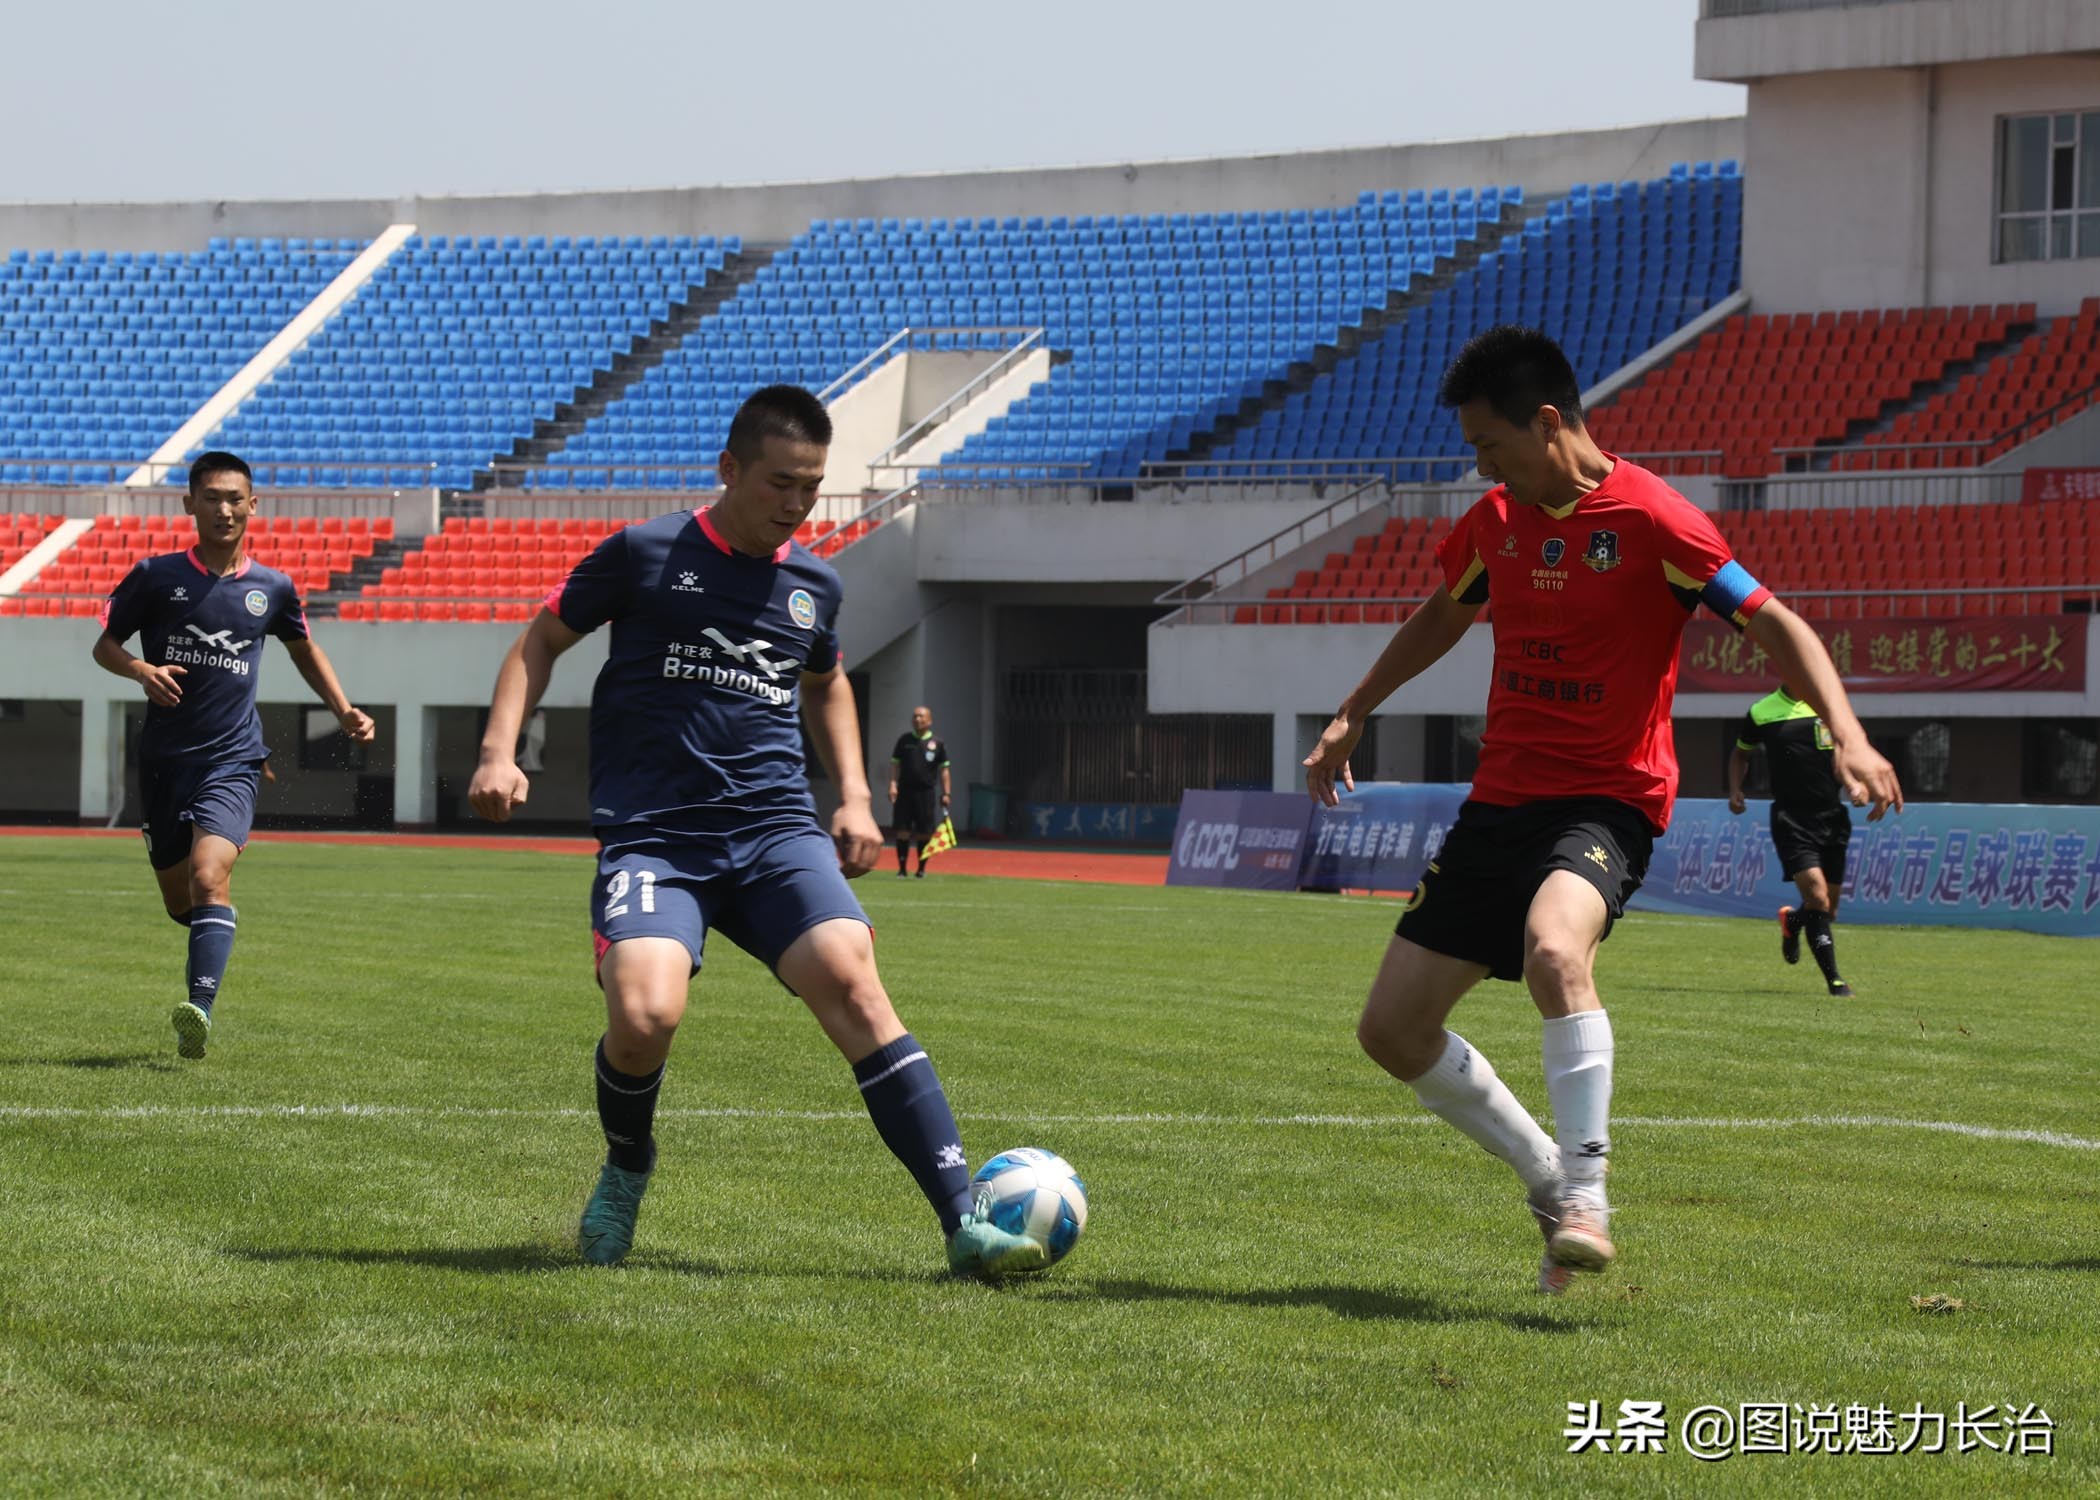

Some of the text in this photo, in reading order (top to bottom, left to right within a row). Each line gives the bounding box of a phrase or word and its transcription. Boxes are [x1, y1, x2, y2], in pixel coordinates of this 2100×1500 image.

[671, 584, 704, 593] KELME
[1533, 579, 1564, 591] 96110
[165, 646, 249, 675] Bznbiology
[668, 642, 713, 659] 北正农
[1521, 640, 1566, 662] ICBC
[1869, 625, 2065, 677] 迎接党的二十大
[1315, 819, 1415, 859] 打击电信诈骗
[604, 870, 656, 922] 21
